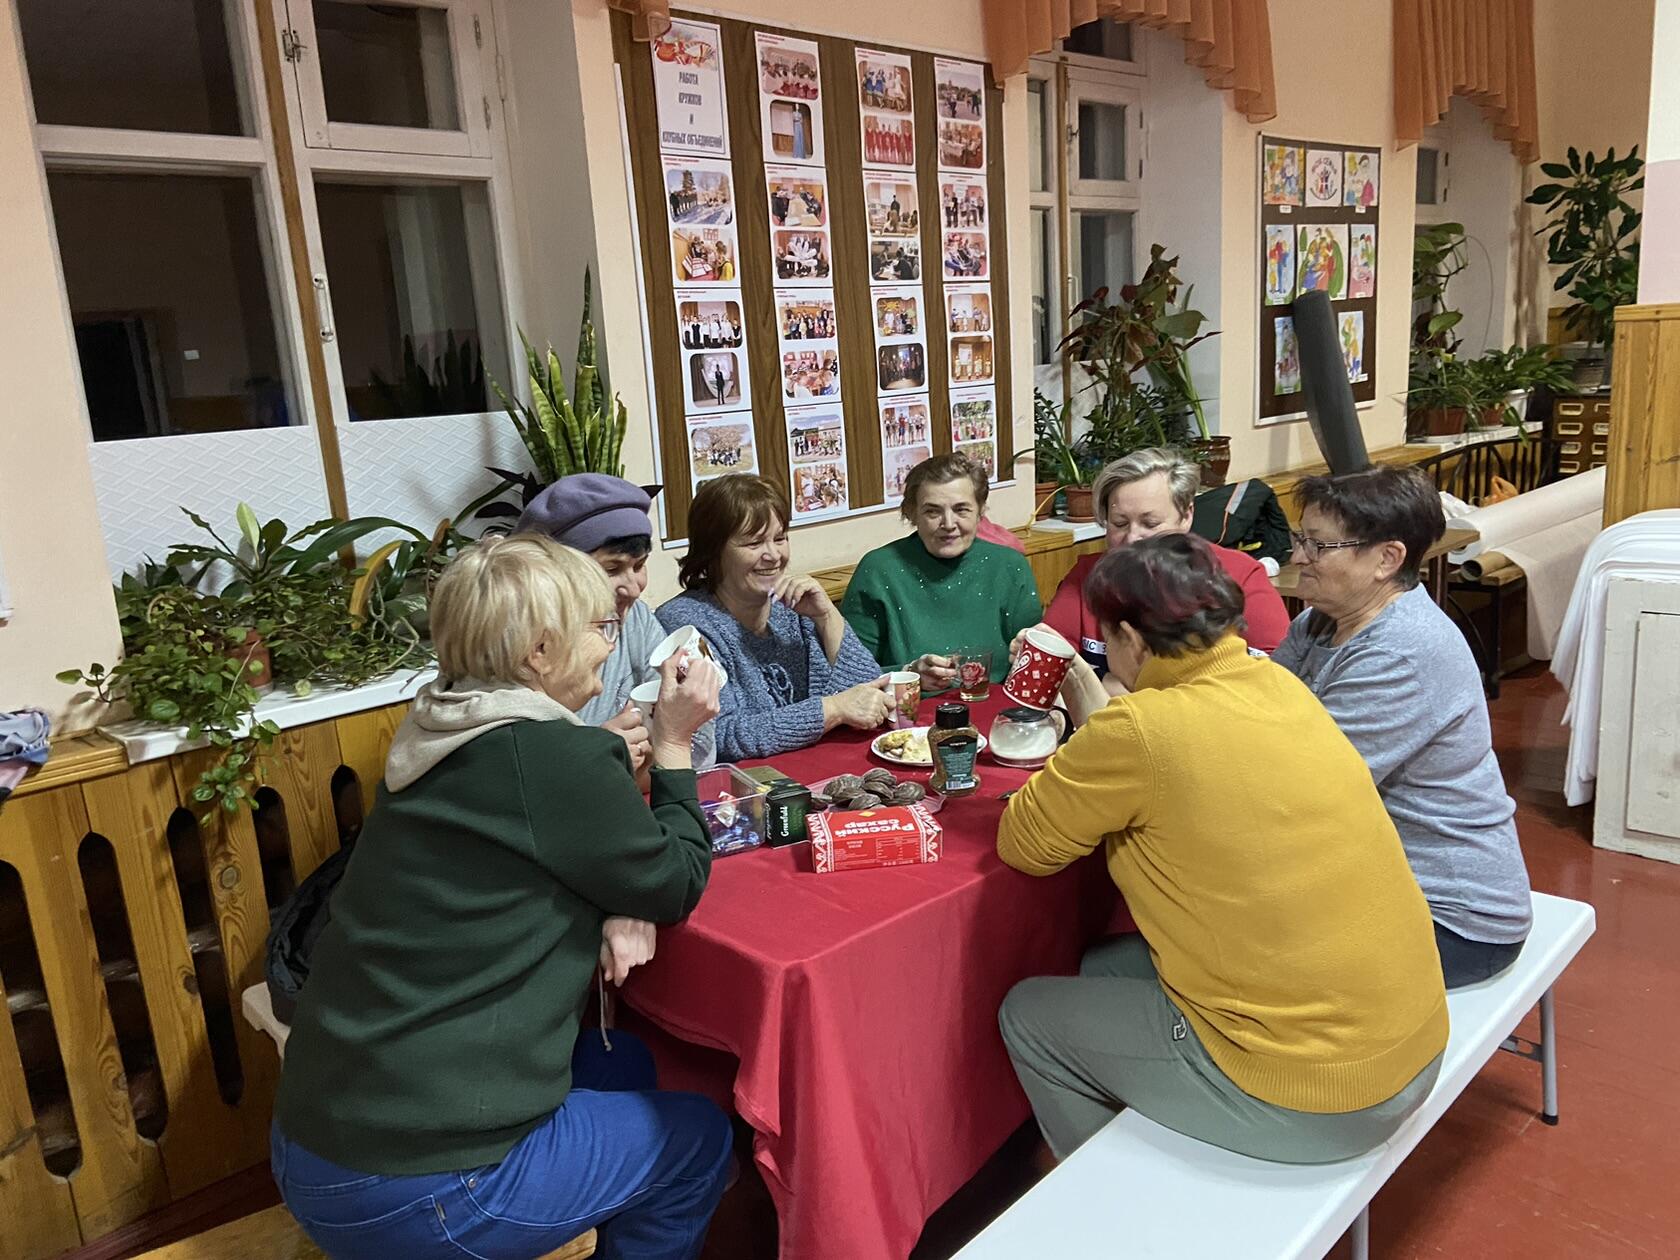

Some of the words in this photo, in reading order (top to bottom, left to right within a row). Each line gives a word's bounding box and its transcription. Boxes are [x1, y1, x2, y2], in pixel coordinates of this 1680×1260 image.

[679, 71, 699, 85] РАБОТА
[678, 92, 702, 106] КРУЖКОВ
[662, 131, 687, 145] КЛУБНЫХ
[687, 134, 723, 149] ОБЪЕДИНЕНИЙ
[779, 806, 789, 837] Greenfield
[844, 818, 900, 829] сахар
[835, 823, 915, 837] Русский
